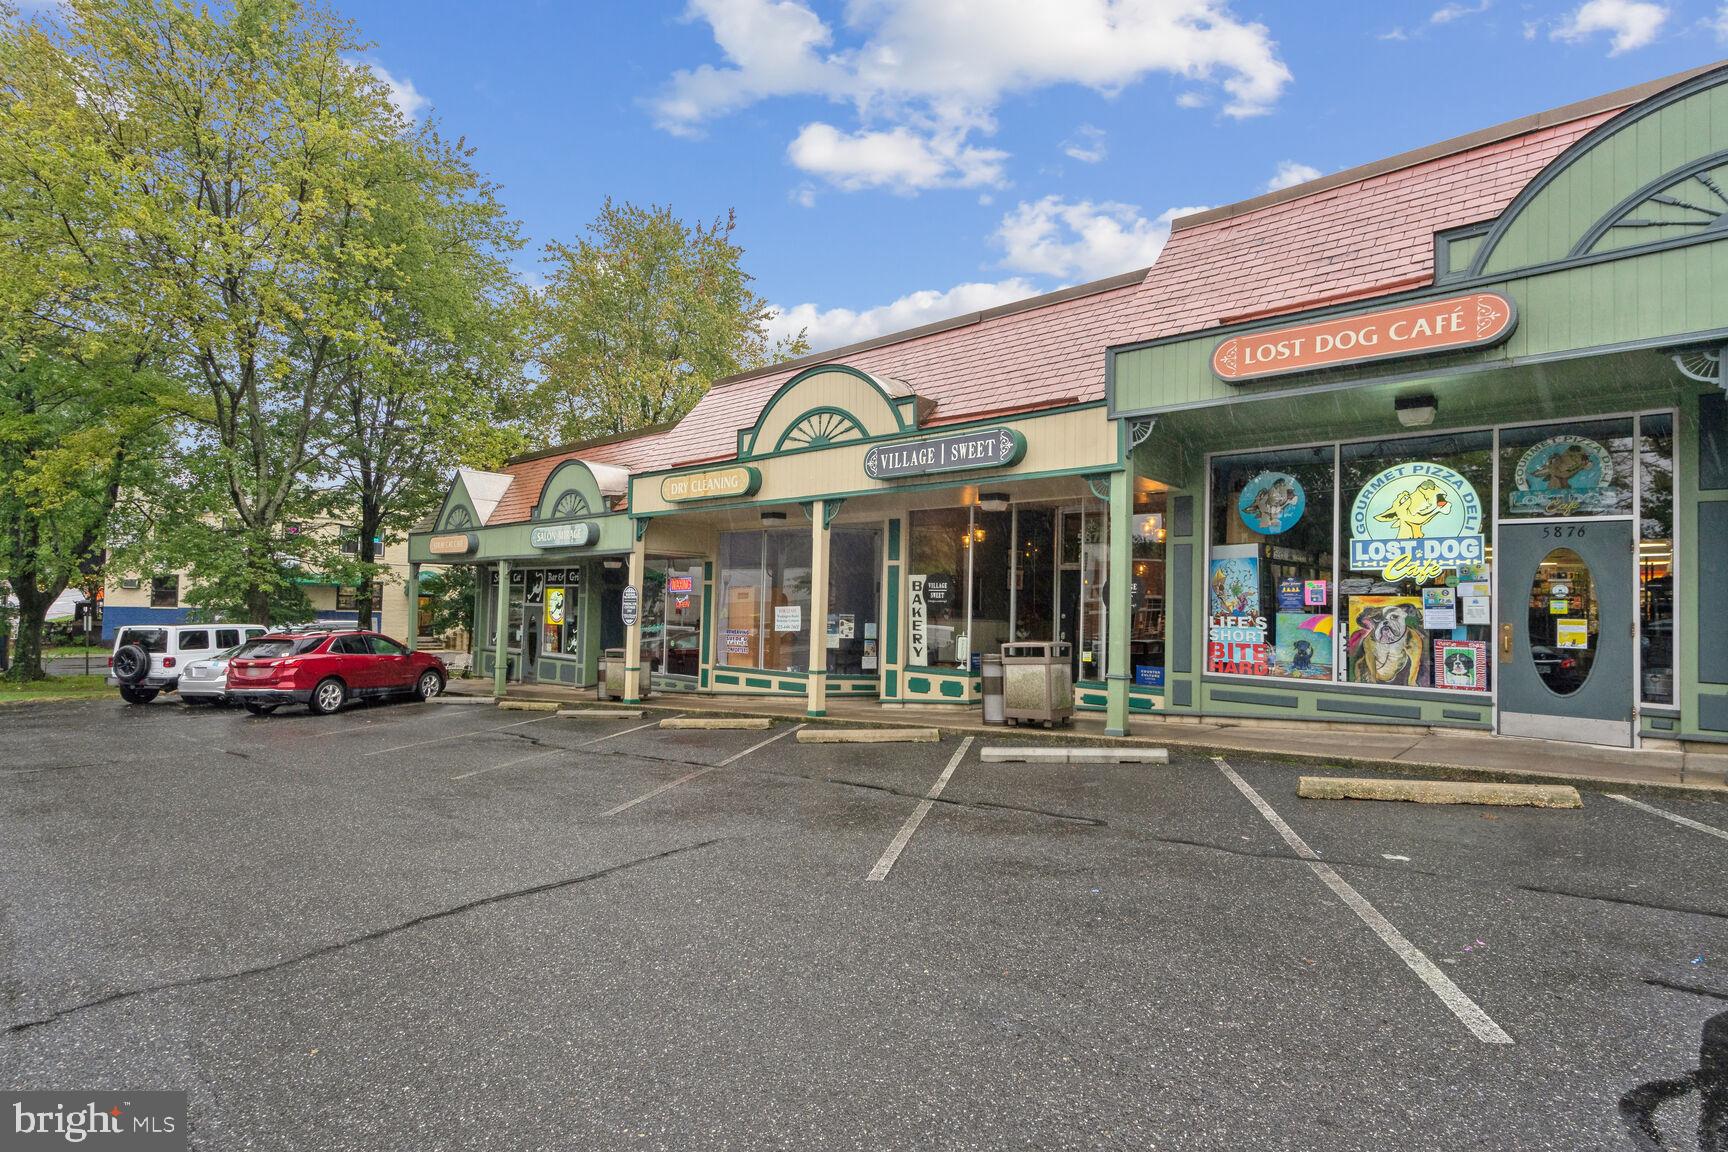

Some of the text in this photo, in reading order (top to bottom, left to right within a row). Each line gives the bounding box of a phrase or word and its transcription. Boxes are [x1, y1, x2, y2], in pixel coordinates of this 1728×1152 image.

[1244, 307, 1466, 365] LOST DOG CAFÉ
[881, 439, 996, 469] VILLAGE SWEET
[1517, 436, 1556, 485] GOURMET
[671, 475, 738, 495] DRY CLEANING
[1355, 465, 1478, 534] GOURMET PIZZA DELI
[536, 531, 556, 542] SALON
[1542, 526, 1585, 539] 5876
[1355, 539, 1480, 560] LOST DOG
[912, 581, 923, 657] BAKERY
[1209, 616, 1267, 629] LIFE'S
[1209, 630, 1267, 642] SHORT
[1209, 642, 1268, 661] BITE
[1209, 660, 1269, 676] HARD
